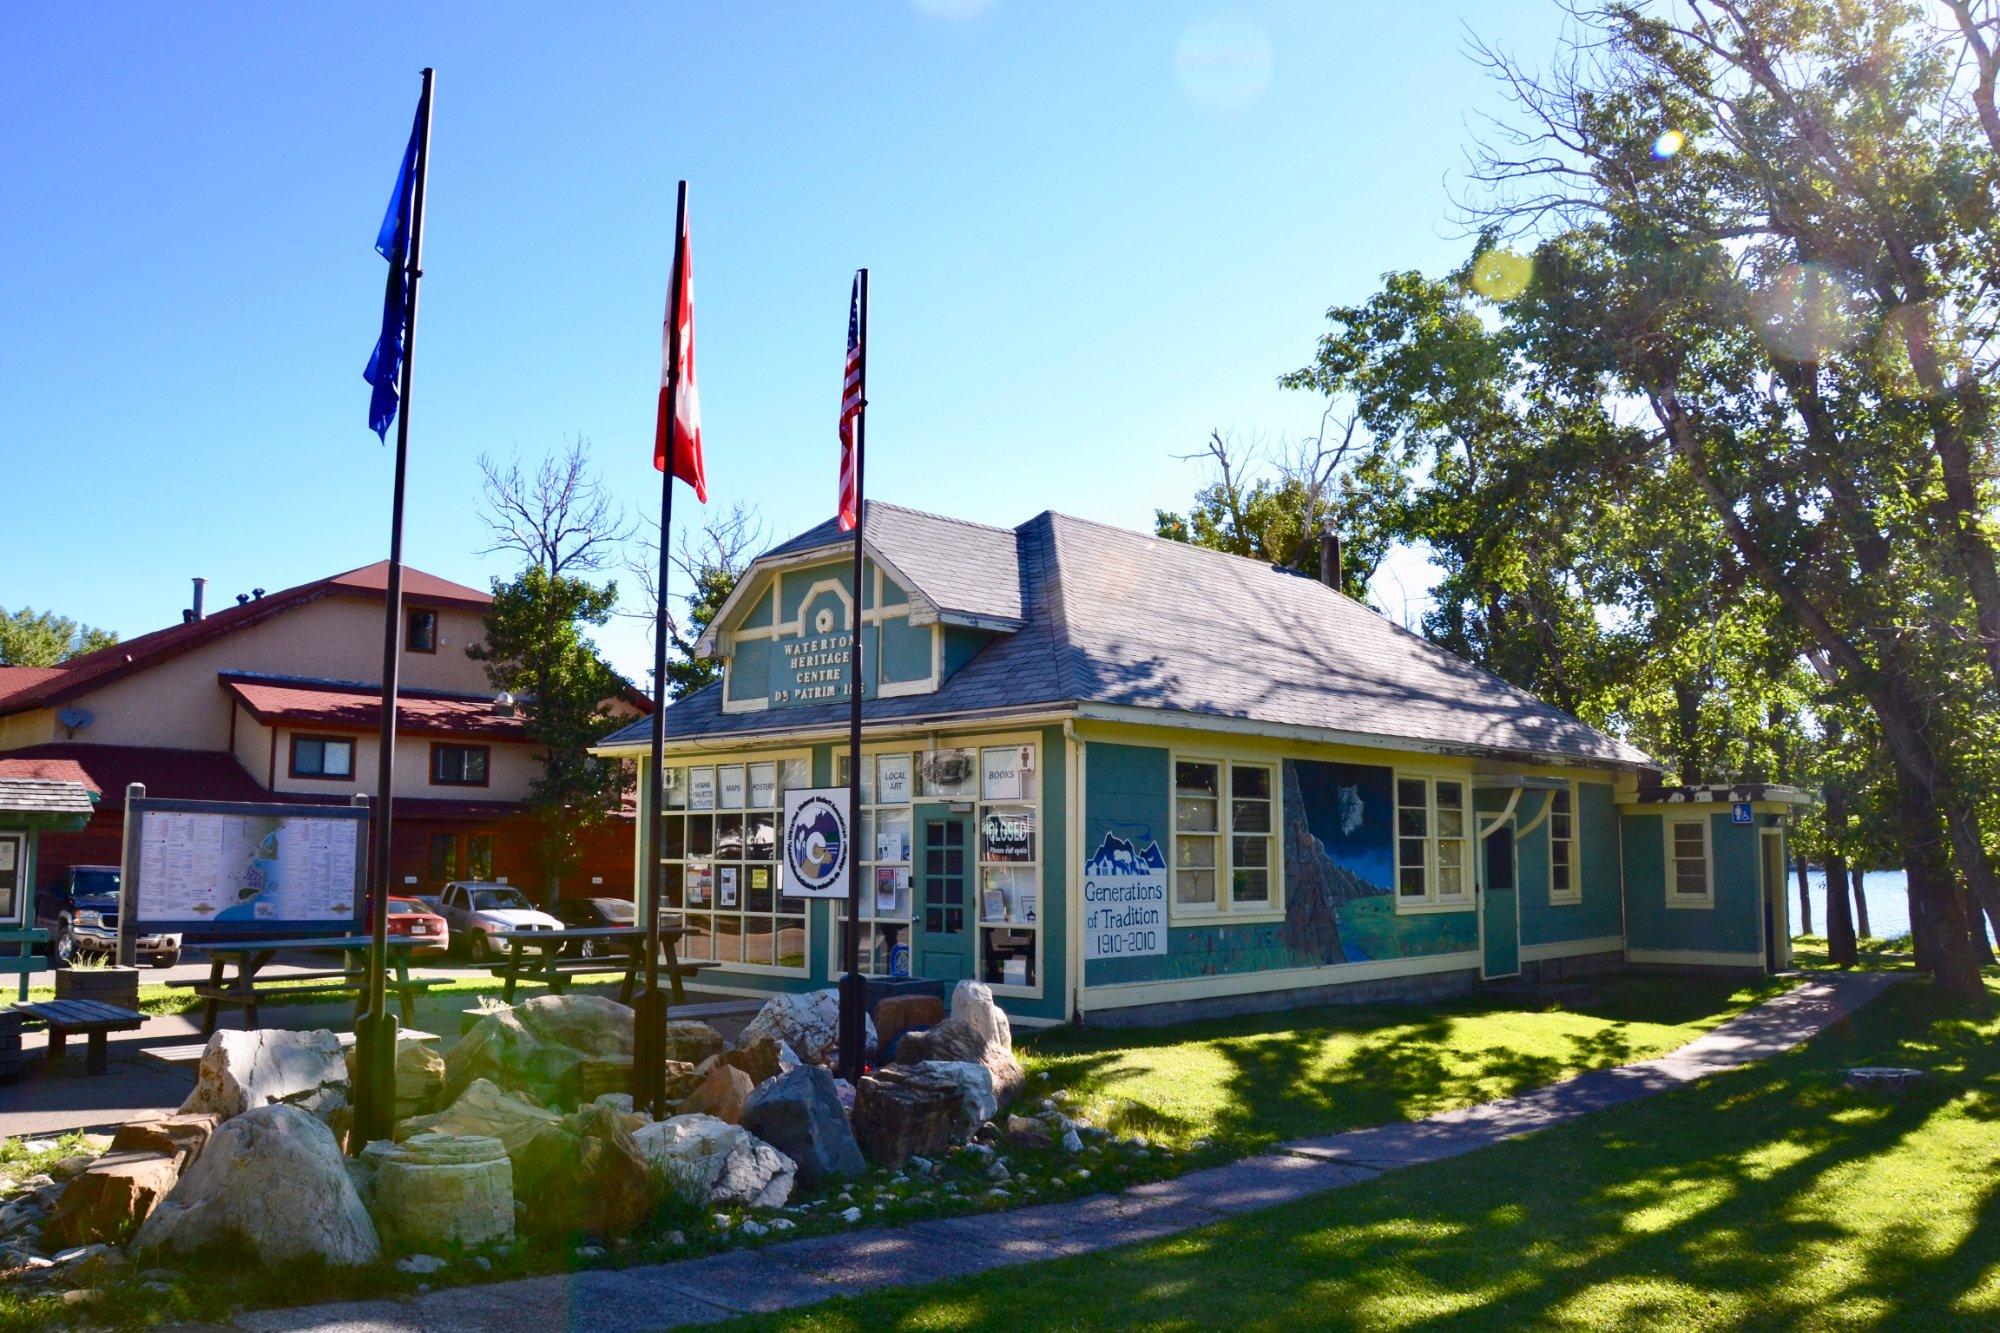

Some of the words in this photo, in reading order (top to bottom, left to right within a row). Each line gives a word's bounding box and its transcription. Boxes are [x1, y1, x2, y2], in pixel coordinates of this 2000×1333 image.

[790, 652, 850, 669] HERITAGE
[796, 669, 841, 683] CENTRE
[885, 771, 906, 780] LOCAL
[988, 770, 1015, 780] BOOKS
[726, 784, 742, 792] MAPS
[752, 782, 775, 791] POSTERS
[889, 782, 903, 791] ART
[988, 820, 1027, 845] CLOSED
[1085, 881, 1163, 902] Generations
[1087, 910, 1098, 929] of
[1100, 906, 1159, 929] Tradition
[1097, 931, 1156, 955] 1910-2010
